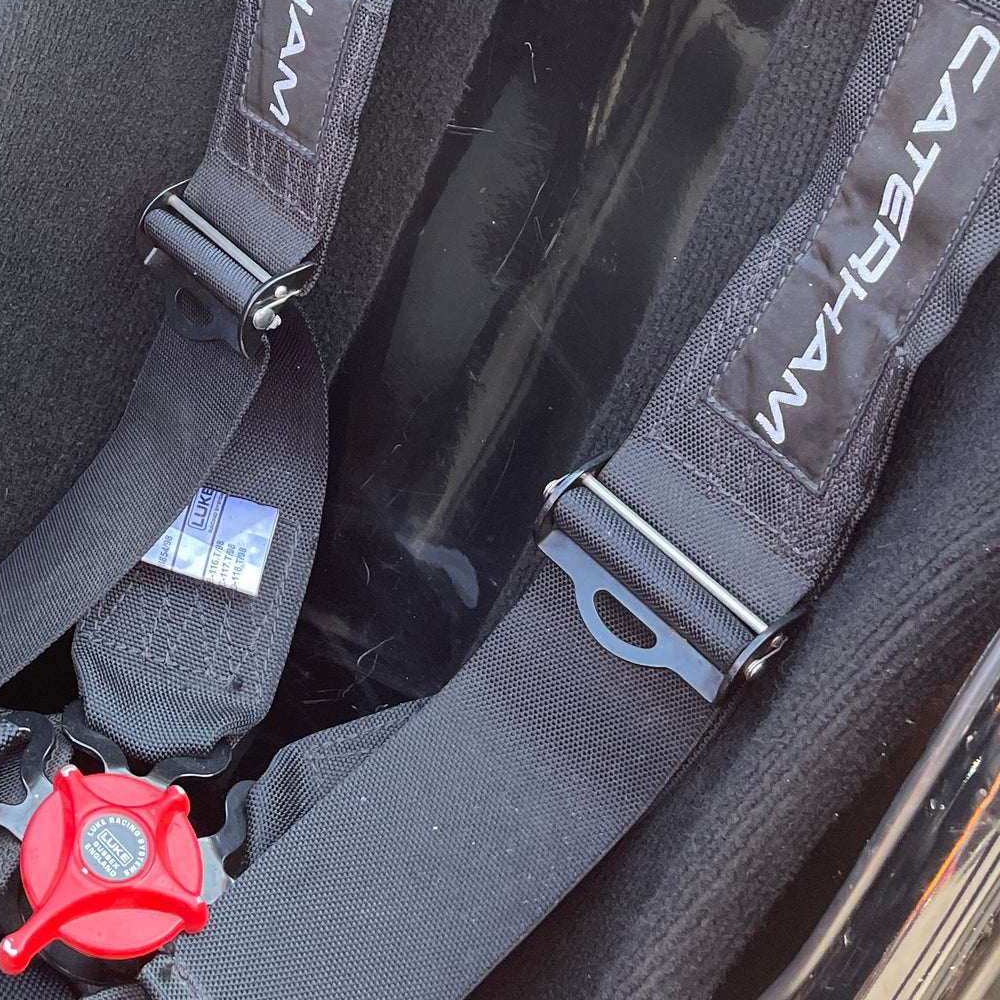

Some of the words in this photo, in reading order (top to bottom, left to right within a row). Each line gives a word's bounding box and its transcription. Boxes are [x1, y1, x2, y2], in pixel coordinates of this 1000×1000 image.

[755, 24, 1000, 445] CATERHAM
[191, 487, 213, 528] LUKE
[87, 819, 107, 837] LUKE
[109, 816, 141, 837] RACING
[84, 843, 117, 877] ENGLAND
[92, 840, 120, 870] SUSSEX
[100, 832, 131, 864] LUKE
[123, 838, 146, 877] SYSTEMS
